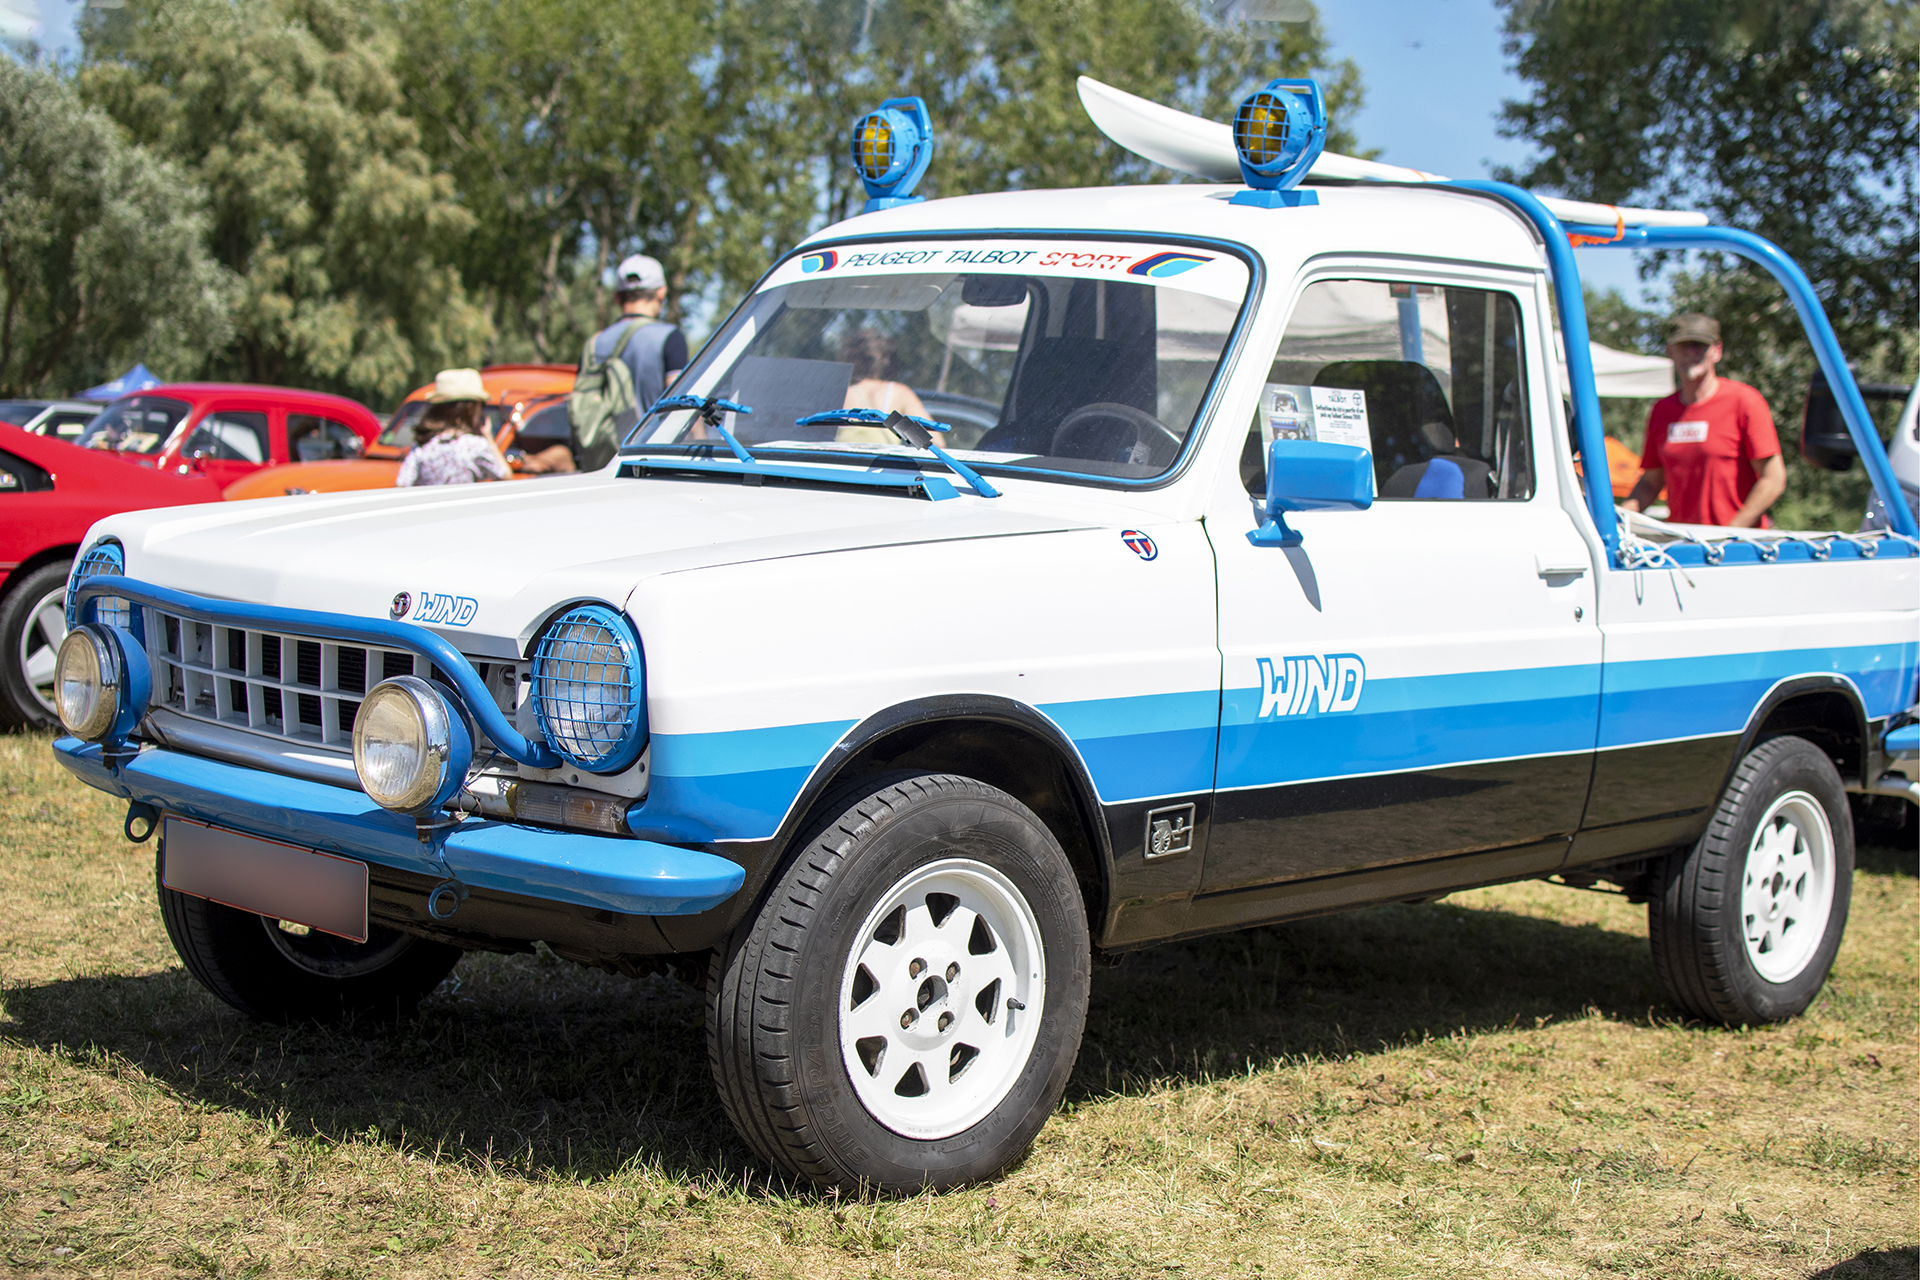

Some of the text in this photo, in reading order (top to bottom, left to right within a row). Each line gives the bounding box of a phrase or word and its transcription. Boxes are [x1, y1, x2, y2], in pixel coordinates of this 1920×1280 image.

[841, 249, 1132, 271] PEUGEOT TALBOT SPORT
[413, 591, 480, 627] WIND
[1256, 652, 1366, 718] WIND
[805, 1043, 871, 1167] SINCERA
